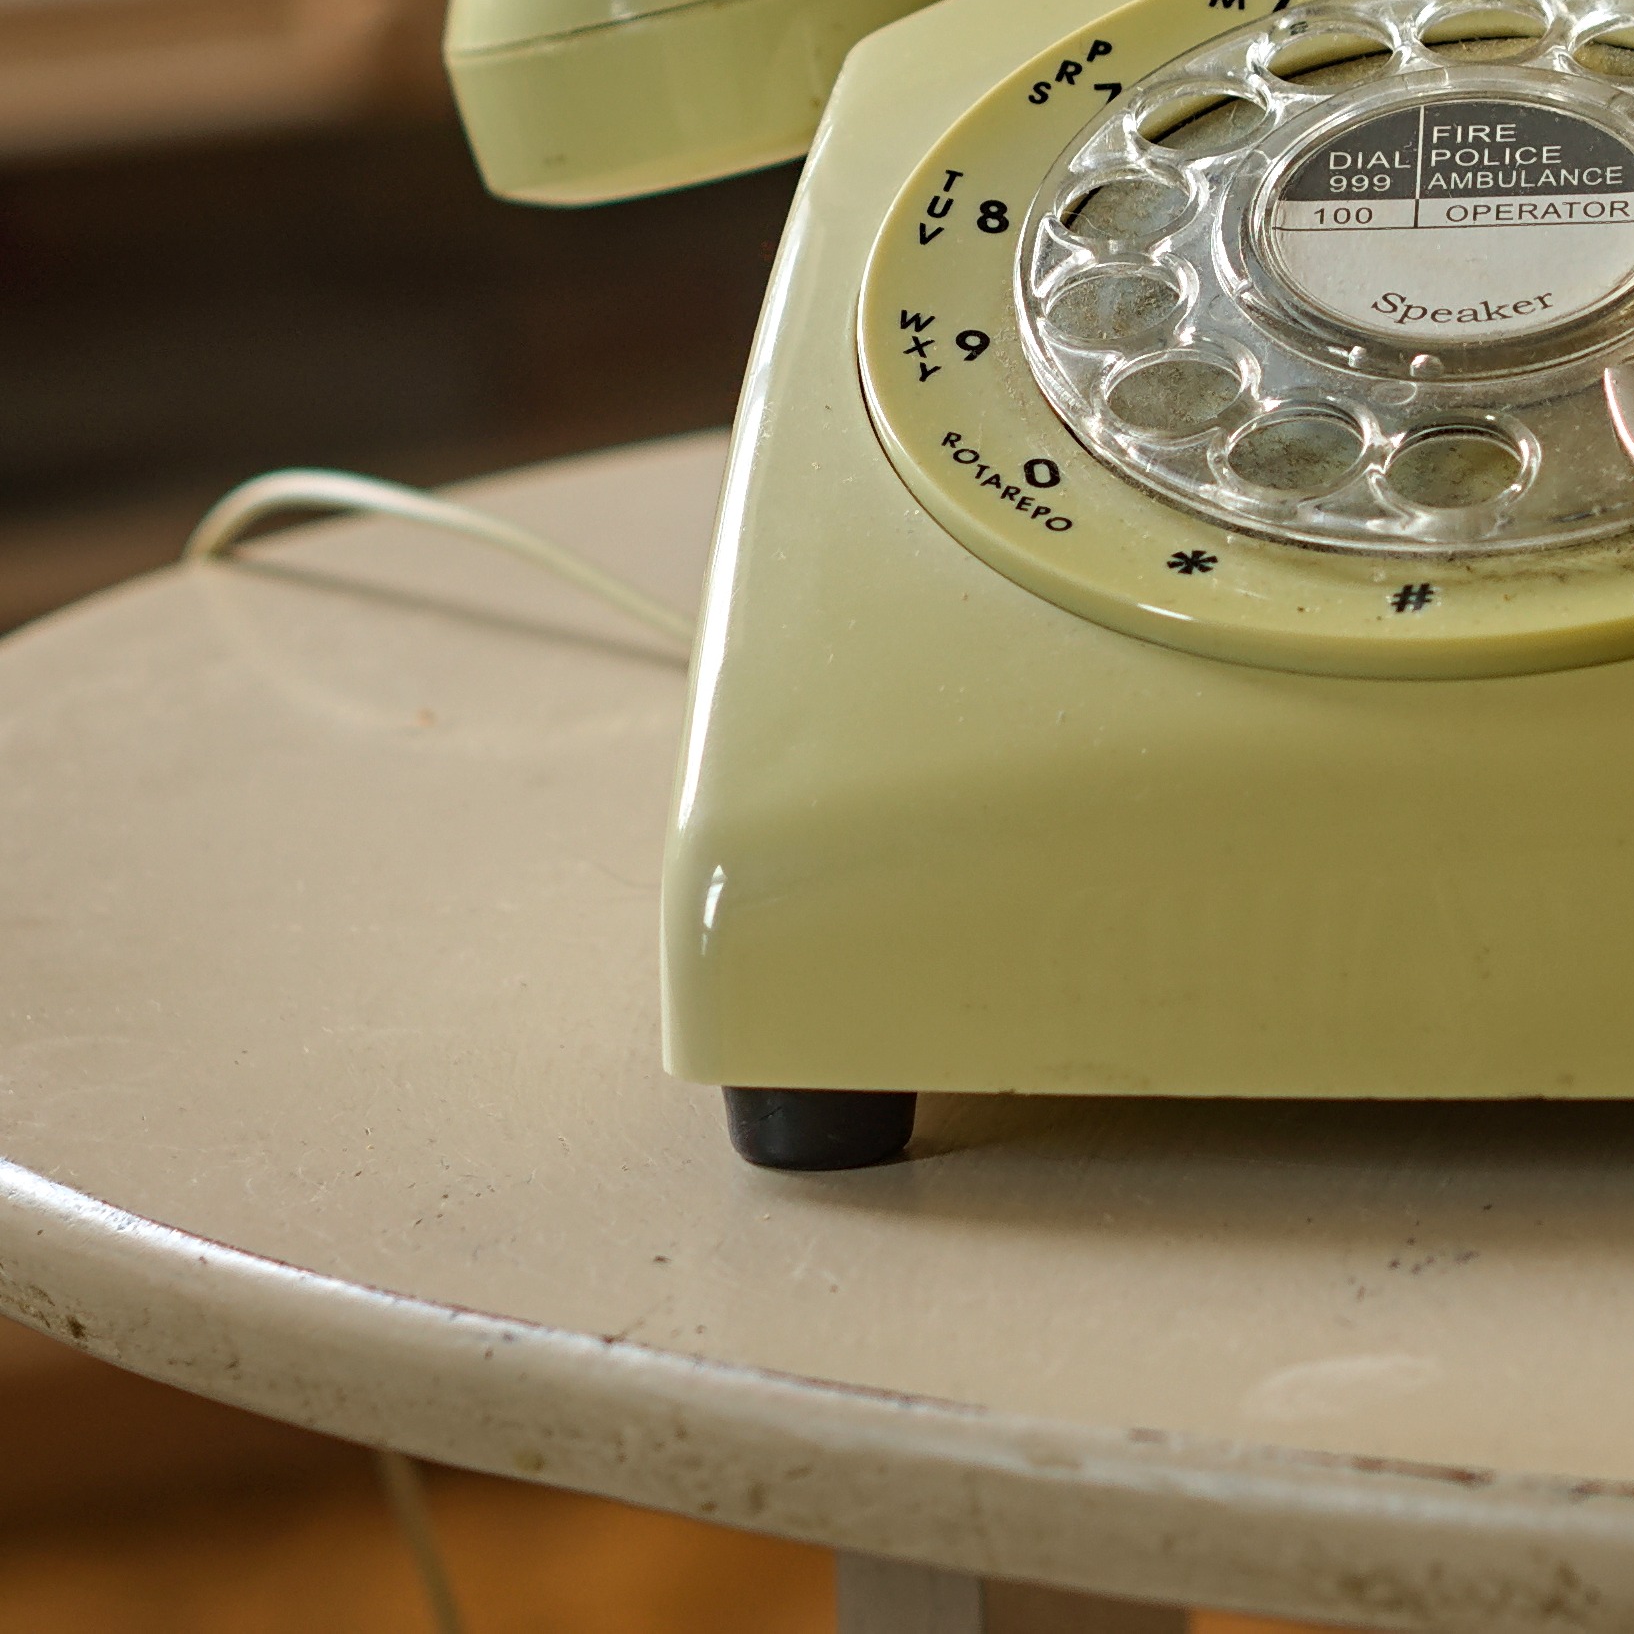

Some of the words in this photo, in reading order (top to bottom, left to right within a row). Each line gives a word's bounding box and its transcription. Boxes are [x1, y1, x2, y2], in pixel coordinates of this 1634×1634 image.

[1432, 123, 1517, 144] FIRE
[1329, 150, 1411, 170] DIAL
[1430, 145, 1562, 167] POLICE
[1329, 174, 1391, 193] 999
[1427, 166, 1623, 190] AMBULANCE
[919, 169, 964, 245] TUV
[976, 199, 1010, 234] 8
[1313, 207, 1374, 225] 100
[1445, 200, 1631, 223] OPERATOR
[1371, 291, 1554, 324] Speaker
[900, 309, 942, 383] WXY
[955, 329, 991, 362] 9
